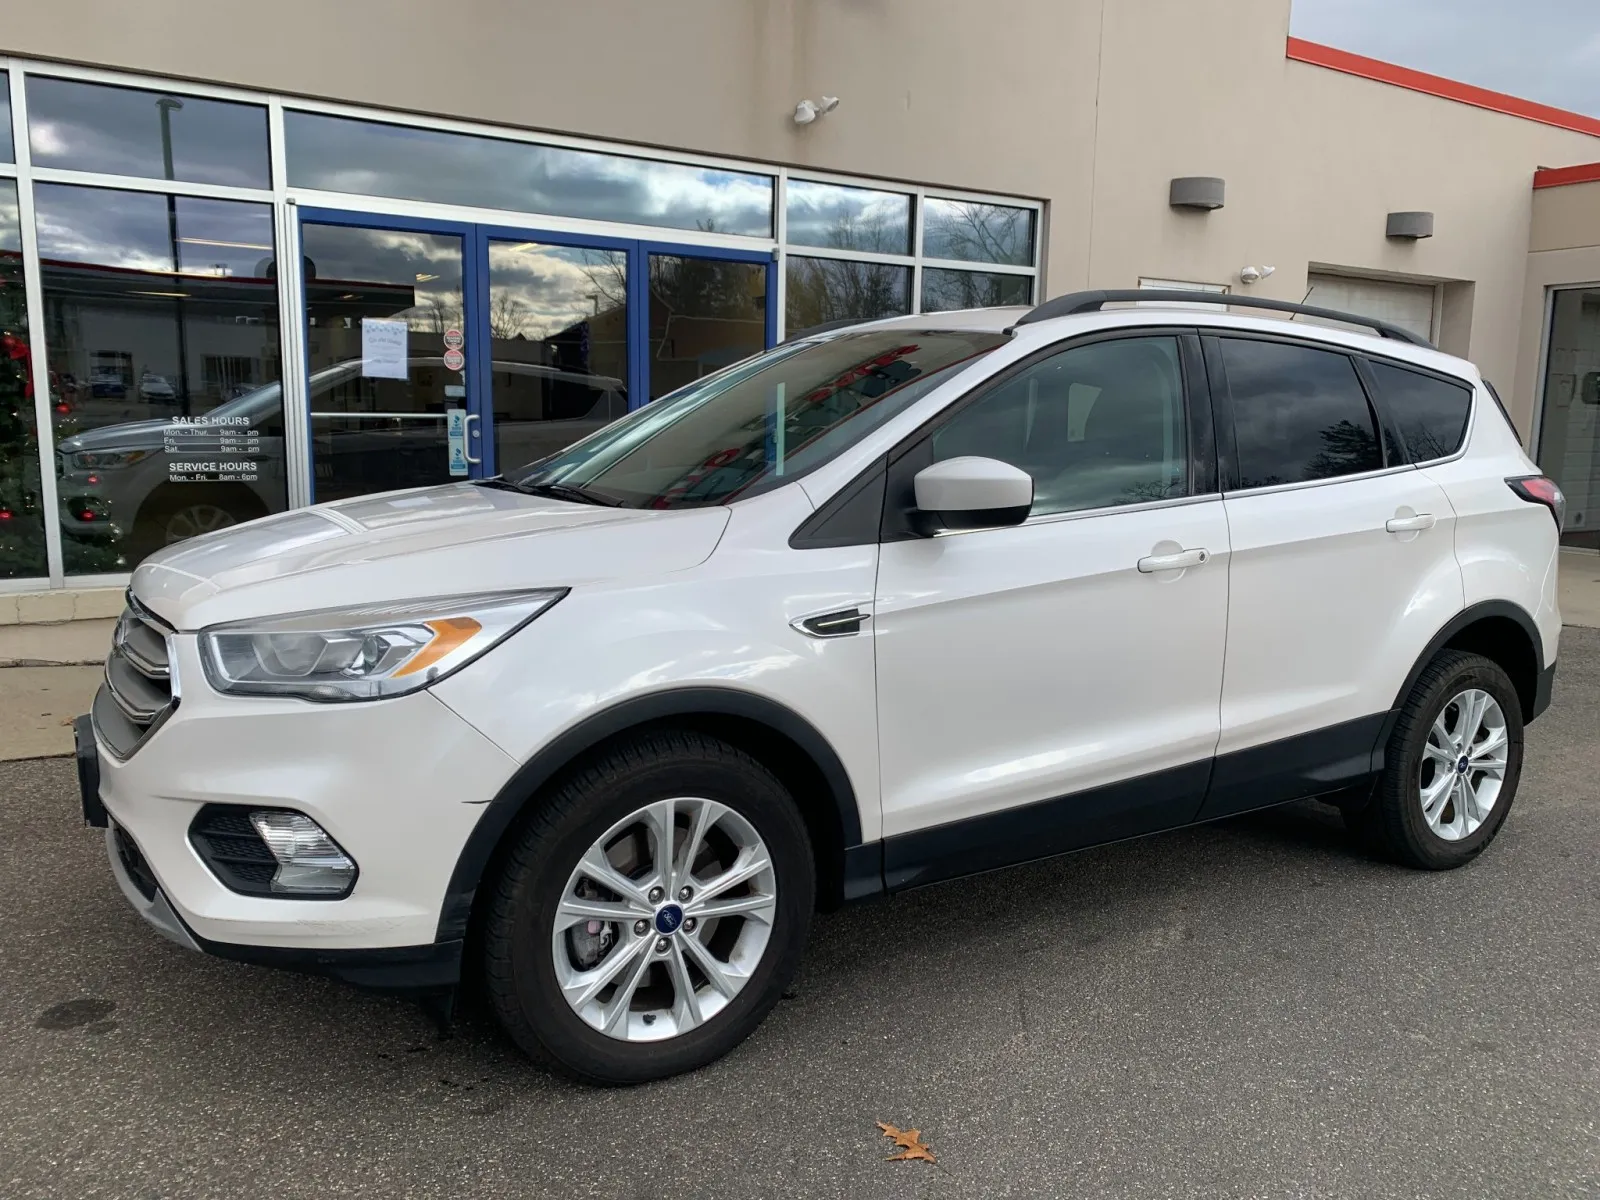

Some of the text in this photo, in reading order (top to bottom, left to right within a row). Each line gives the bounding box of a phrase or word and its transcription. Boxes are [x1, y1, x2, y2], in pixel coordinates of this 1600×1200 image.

[172, 416, 250, 425] SALES HOURS
[169, 462, 257, 471] SERVICE HOURS
